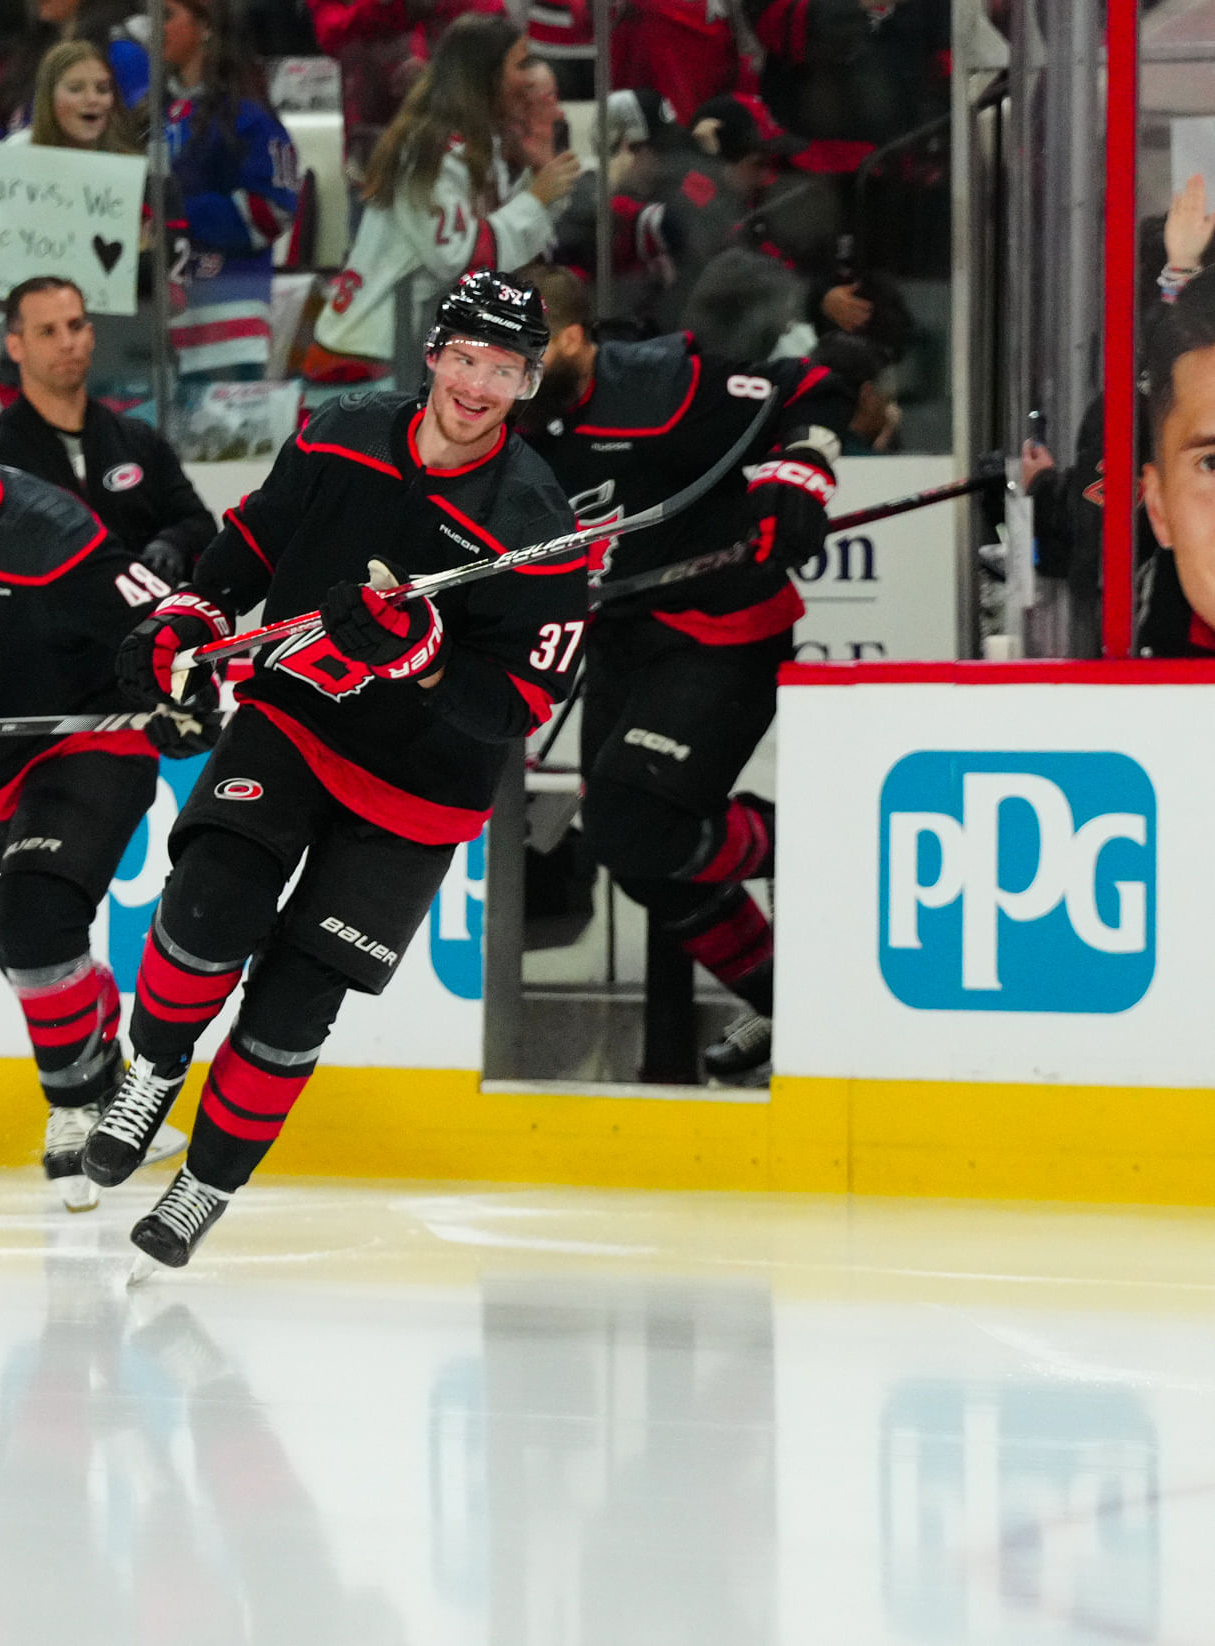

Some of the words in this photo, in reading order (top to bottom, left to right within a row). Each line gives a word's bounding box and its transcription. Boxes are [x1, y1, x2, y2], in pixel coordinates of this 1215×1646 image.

[84, 186, 124, 219] We
[727, 375, 772, 400] 8
[744, 461, 834, 501] CCM
[114, 562, 171, 607] 48
[155, 594, 231, 636] BAUE
[529, 620, 585, 674] 37
[624, 728, 691, 761] CCM
[319, 916, 398, 967] BAUER
